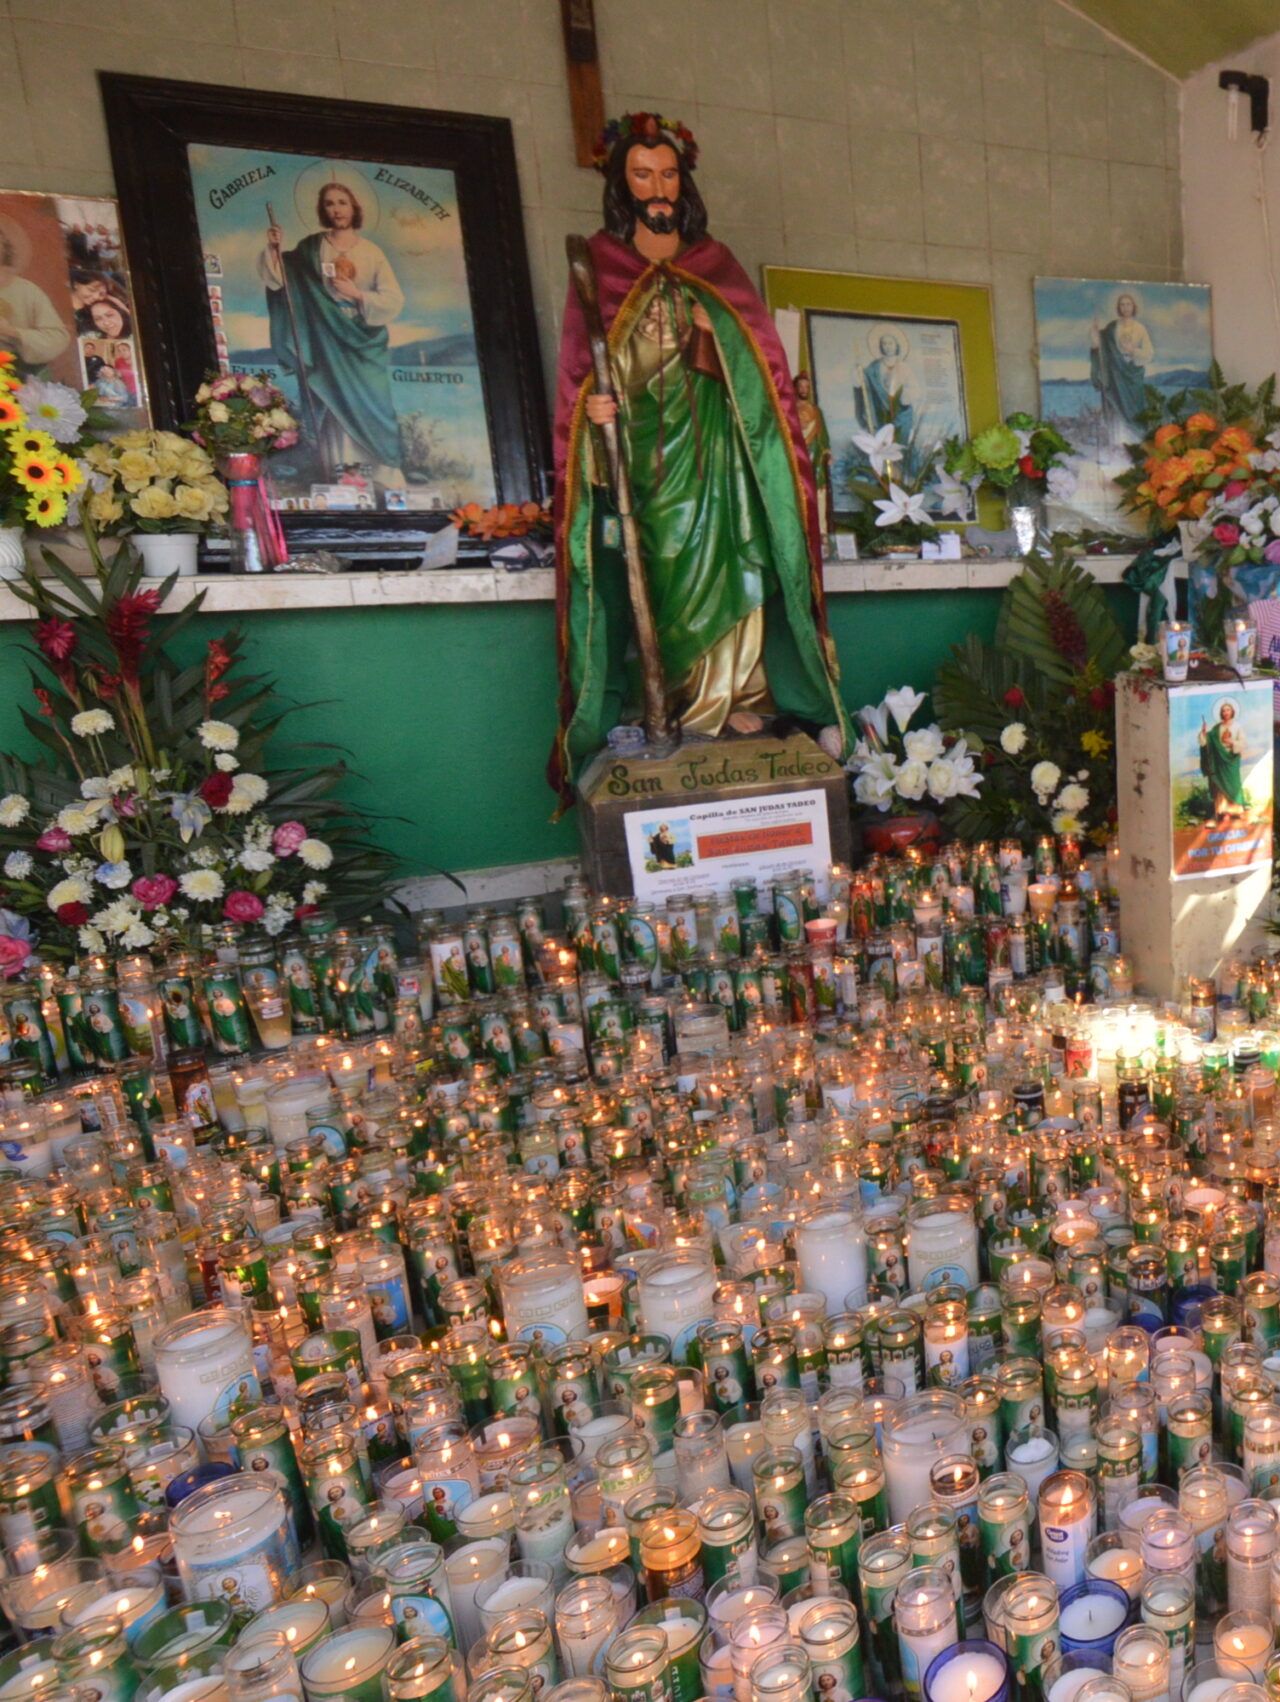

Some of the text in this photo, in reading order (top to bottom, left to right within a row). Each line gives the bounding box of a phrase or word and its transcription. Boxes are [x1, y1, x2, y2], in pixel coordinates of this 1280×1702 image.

[208, 165, 276, 210] GABRIELA
[374, 167, 450, 221] ELIZABETH
[392, 369, 464, 385] GILBERTO
[608, 749, 833, 796] San Judas Tadeo
[689, 811, 724, 821] Capilla
[726, 808, 736, 817] de
[740, 806, 757, 815] SAN
[759, 803, 785, 814] JUDAS
[787, 799, 816, 809] TADEO
